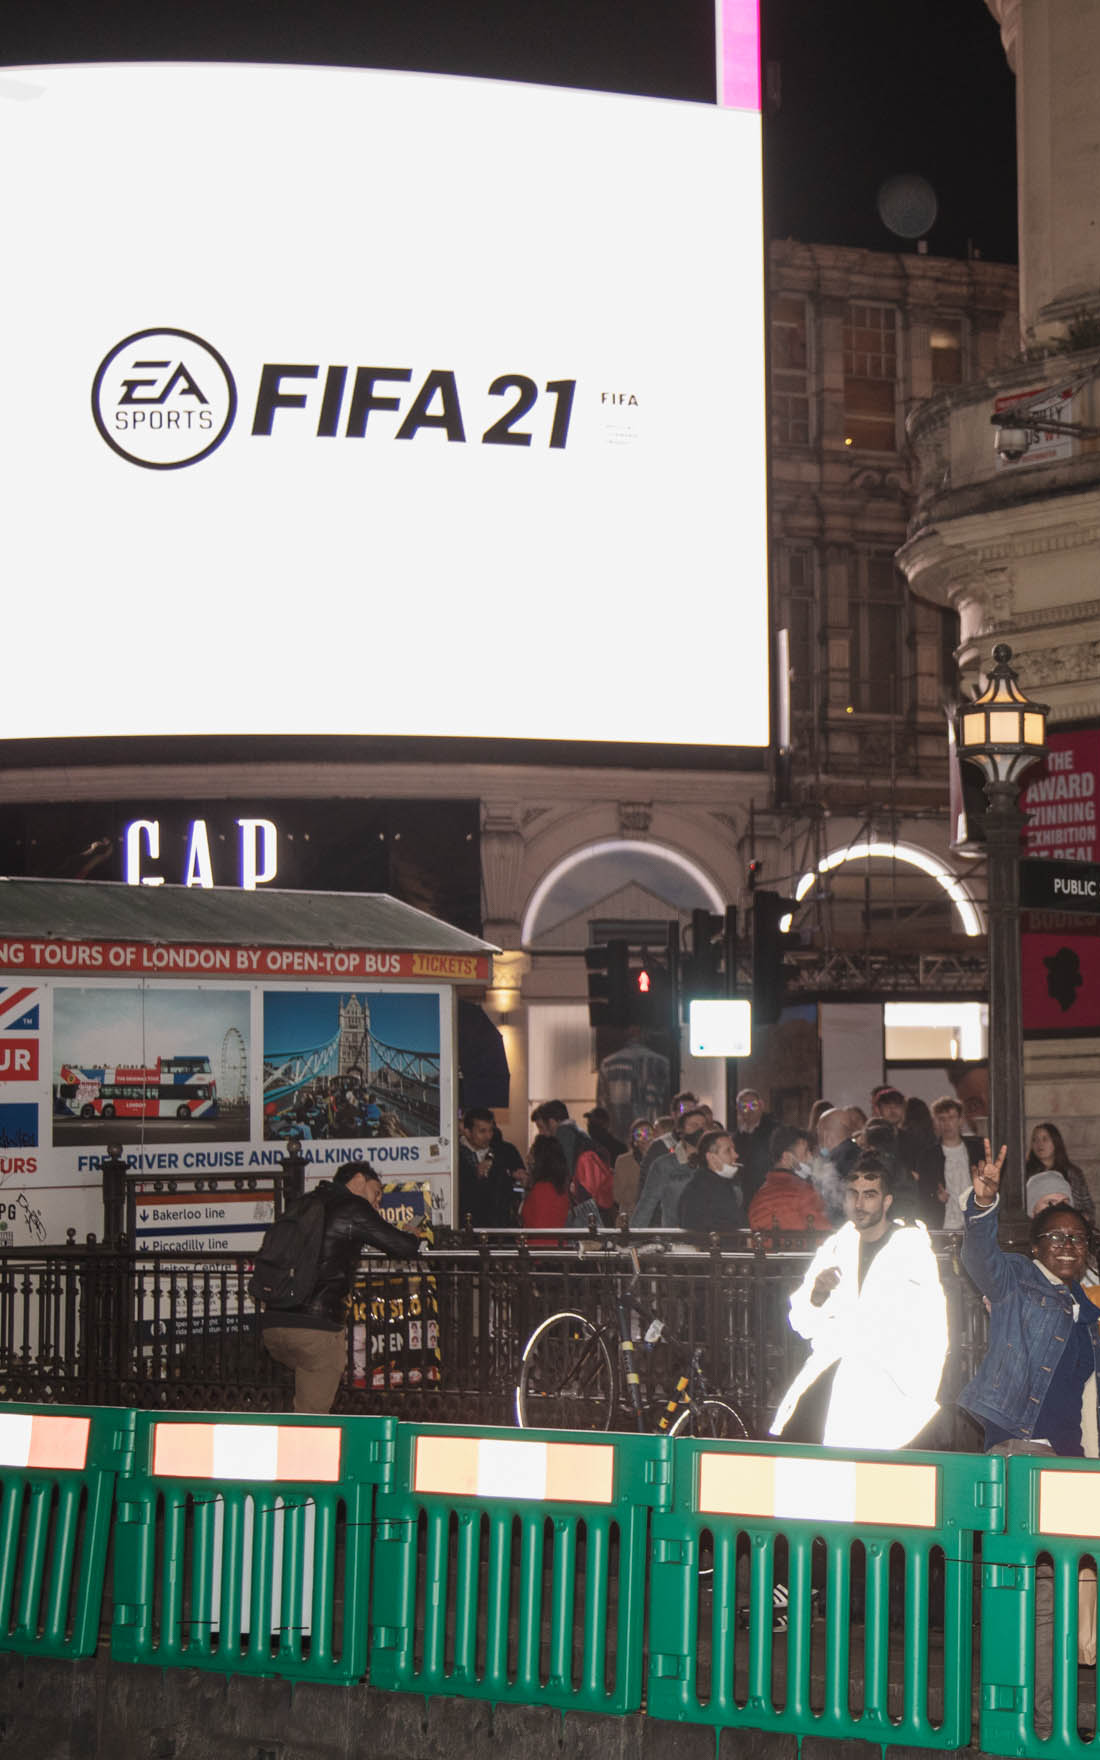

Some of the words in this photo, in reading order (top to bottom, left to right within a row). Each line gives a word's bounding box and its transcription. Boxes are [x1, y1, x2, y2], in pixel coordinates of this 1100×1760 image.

[117, 361, 210, 405] EA
[251, 363, 466, 443] FIFA
[481, 373, 577, 449] 21
[601, 392, 639, 407] FIFA
[115, 410, 213, 430] SPORTS
[1026, 772, 1094, 803] AWARD
[1027, 802, 1095, 827] WINNING
[1028, 825, 1096, 847] EXHIBITION
[124, 818, 278, 891] GAP
[1054, 878, 1097, 897] PUBLIC
[31, 943, 103, 966] TOURS
[109, 946, 137, 967] OF
[142, 946, 231, 969] LONDON
[236, 949, 262, 969] BY
[266, 950, 361, 972] OPEN-TOP
[365, 953, 401, 973] BUS
[417, 953, 473, 975] TICKETS
[128, 1151, 178, 1170] RIVER
[183, 1150, 244, 1168] CRUISE
[248, 1149, 285, 1166] AND
[297, 1147, 364, 1164] ALKING
[368, 1145, 420, 1162] TOURS
[153, 1208, 202, 1221] Bakerloo
[205, 1207, 225, 1219] line
[153, 1239, 205, 1252] Piccadilly
[208, 1238, 229, 1250] line
